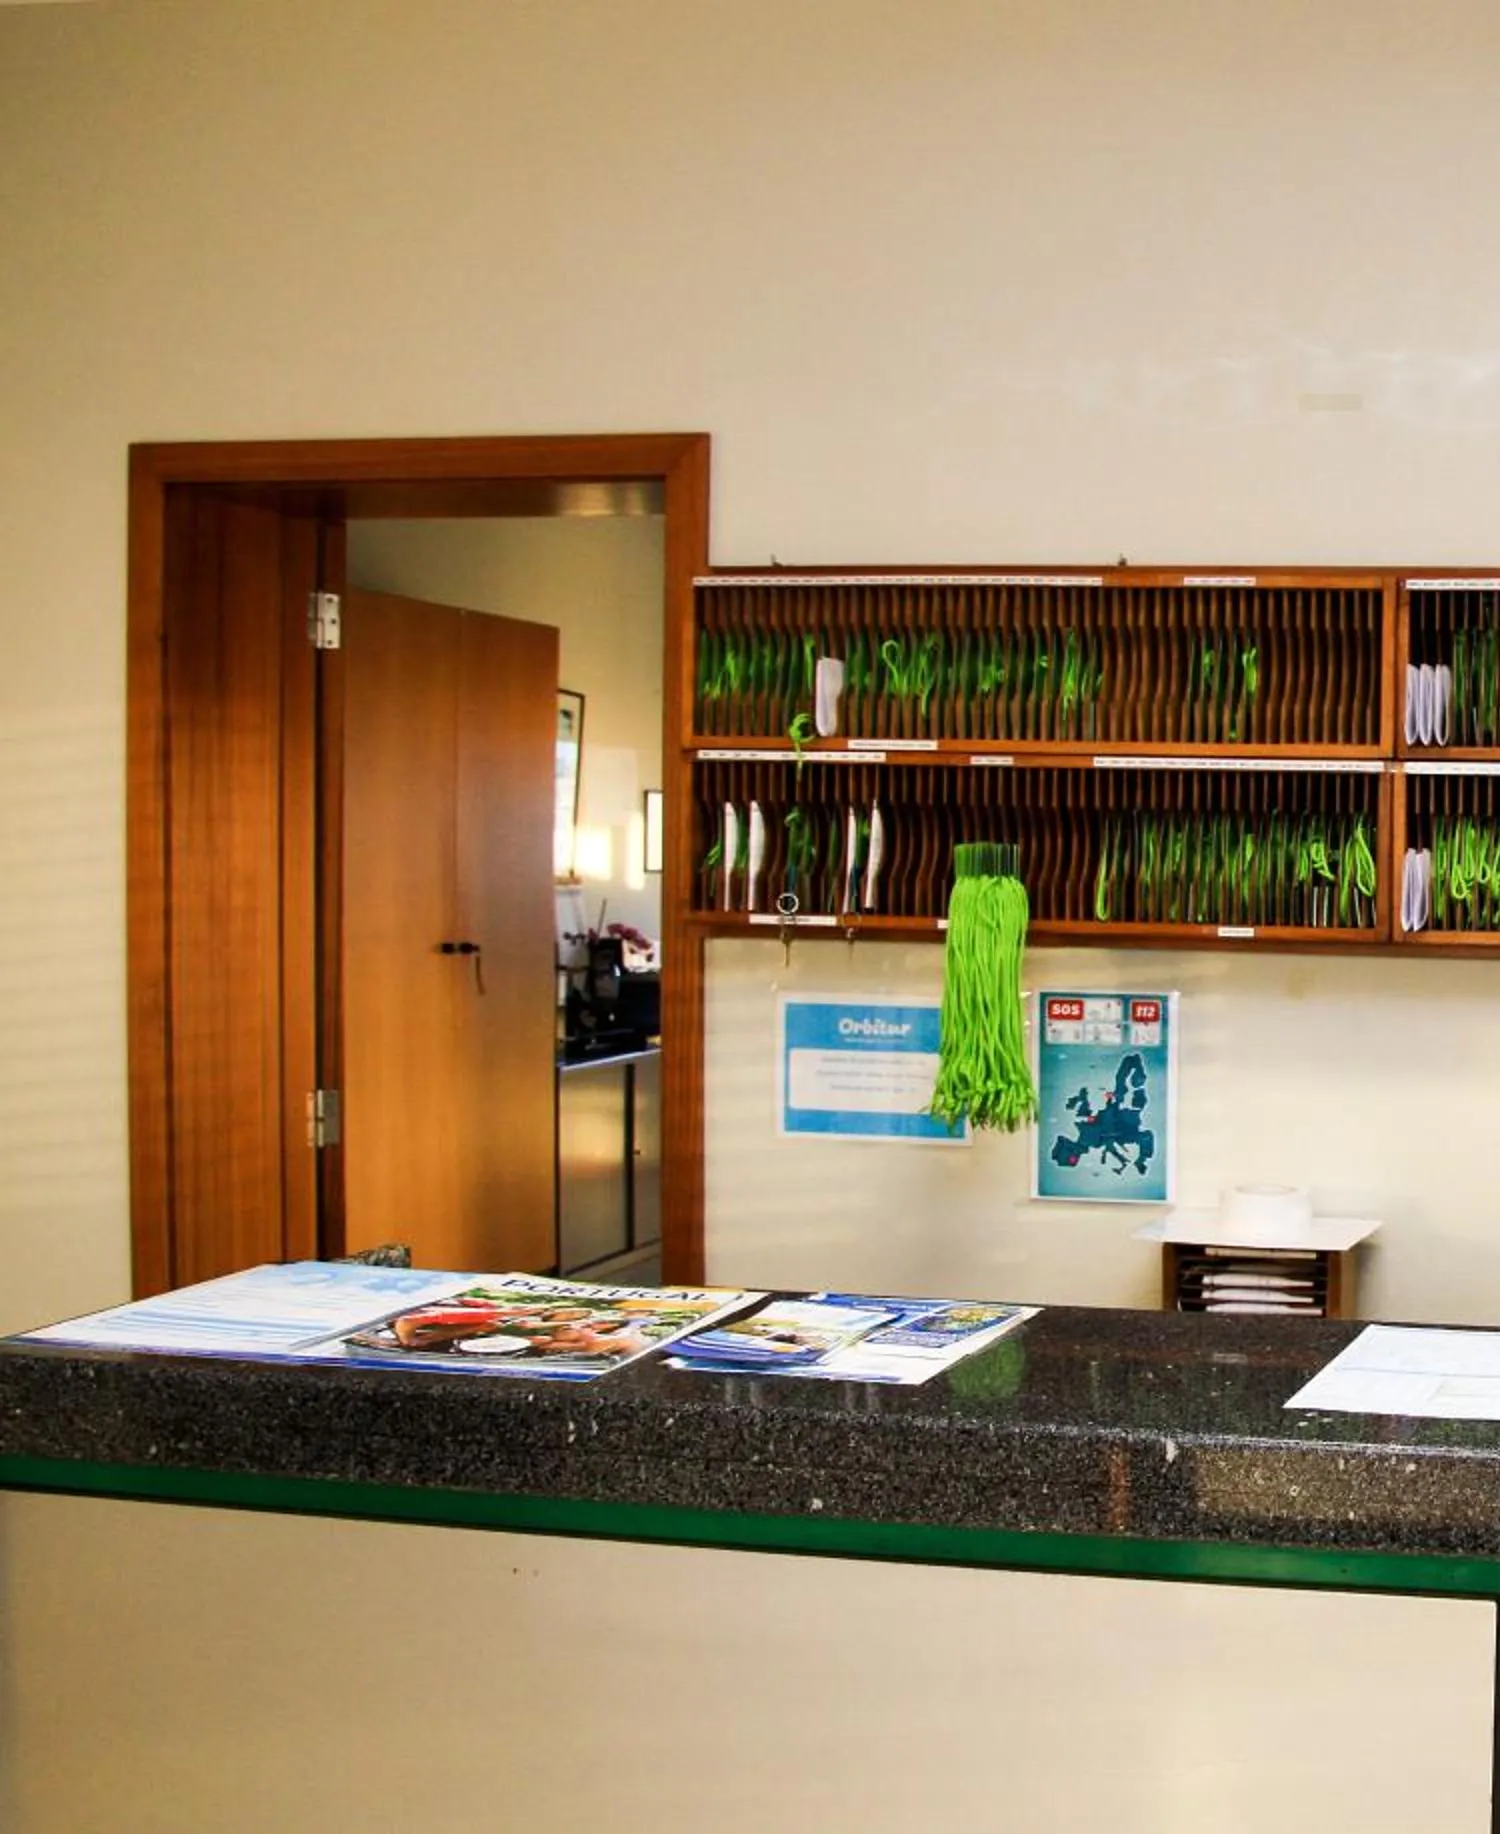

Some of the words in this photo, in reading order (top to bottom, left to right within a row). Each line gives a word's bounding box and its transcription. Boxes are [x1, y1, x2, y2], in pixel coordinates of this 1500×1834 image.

[1051, 1003, 1081, 1016] SOS
[1135, 1005, 1156, 1018] 112
[838, 1016, 912, 1036] Orbitur
[502, 1279, 709, 1301] PORTUGAL
